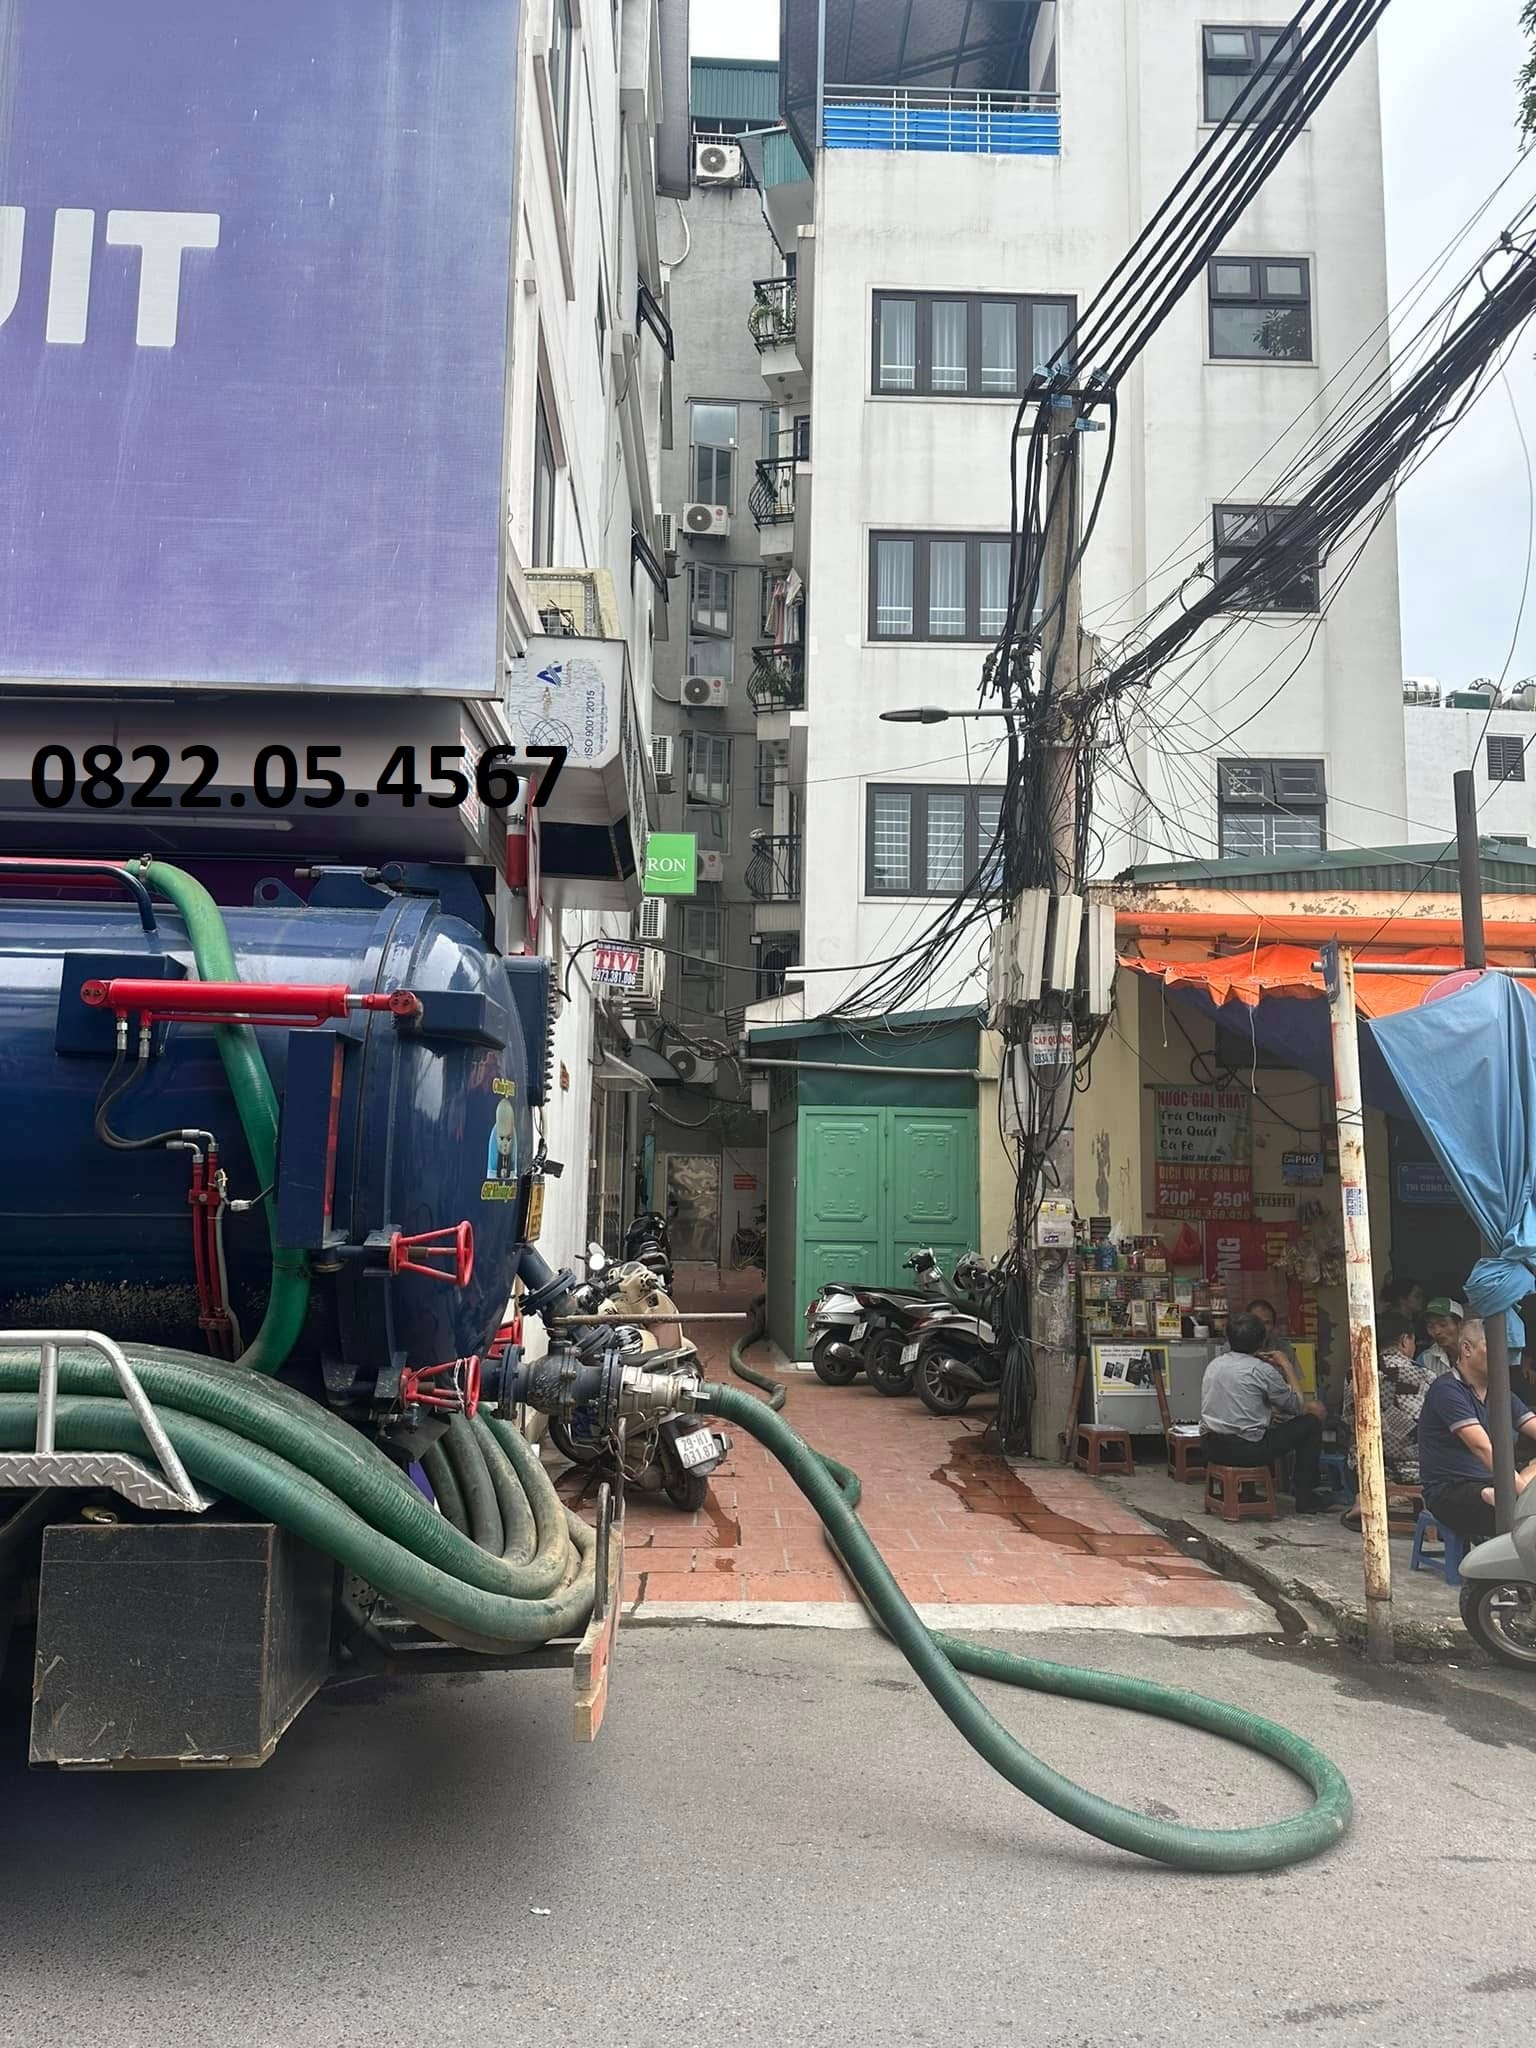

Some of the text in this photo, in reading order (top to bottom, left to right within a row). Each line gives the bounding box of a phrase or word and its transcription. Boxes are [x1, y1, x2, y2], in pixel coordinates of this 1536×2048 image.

[0, 205, 221, 347] IT
[584, 740, 594, 757] ISO
[647, 857, 687, 872] RON
[596, 950, 639, 972] TIVI
[1186, 1111, 1226, 1123] Chanh
